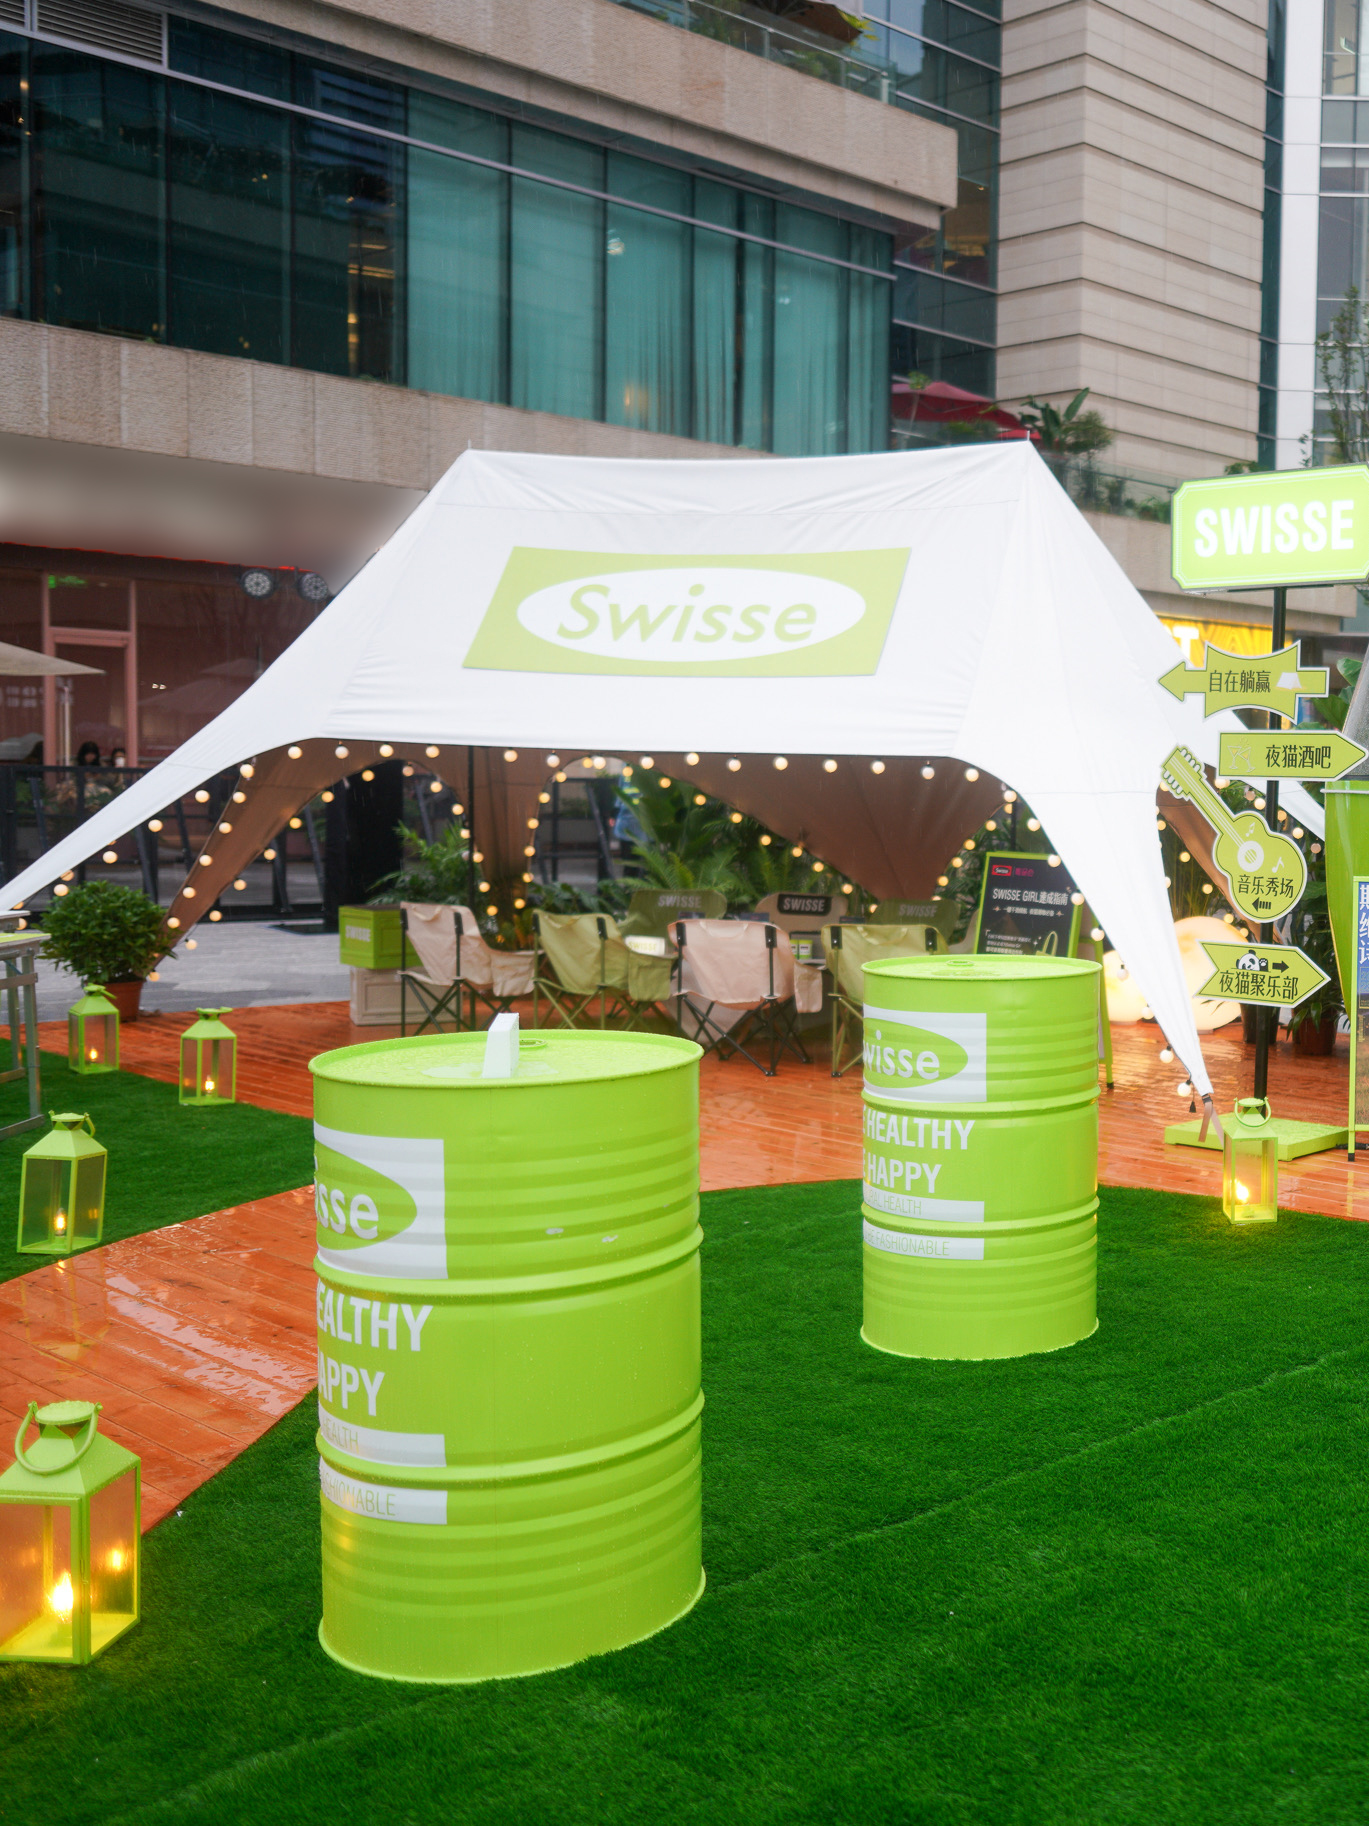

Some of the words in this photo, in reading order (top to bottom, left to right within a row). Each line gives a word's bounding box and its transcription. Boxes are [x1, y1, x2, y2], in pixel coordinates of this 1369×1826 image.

[1193, 499, 1355, 558] SWISSE
[556, 583, 818, 643] Swisse
[1208, 669, 1272, 693] 自在躺赢
[1265, 745, 1331, 770] 夜猫酒吧
[992, 888, 1022, 901] SWISSE
[1237, 874, 1294, 899] 音乐秀场
[657, 895, 702, 908] SWISSE
[783, 897, 825, 912] SWISSE
[899, 904, 938, 918] SWISSE
[1219, 970, 1299, 1000] 夜猫聚乐部
[862, 1029, 940, 1080] wisse
[866, 1107, 976, 1150] HEALTHY
[867, 1151, 942, 1194] HAPPY
[883, 1192, 923, 1216] HEALTH
[875, 1231, 950, 1257] FASHIONABLE
[316, 1276, 434, 1352] EALTHY
[318, 1350, 386, 1417] APPY
